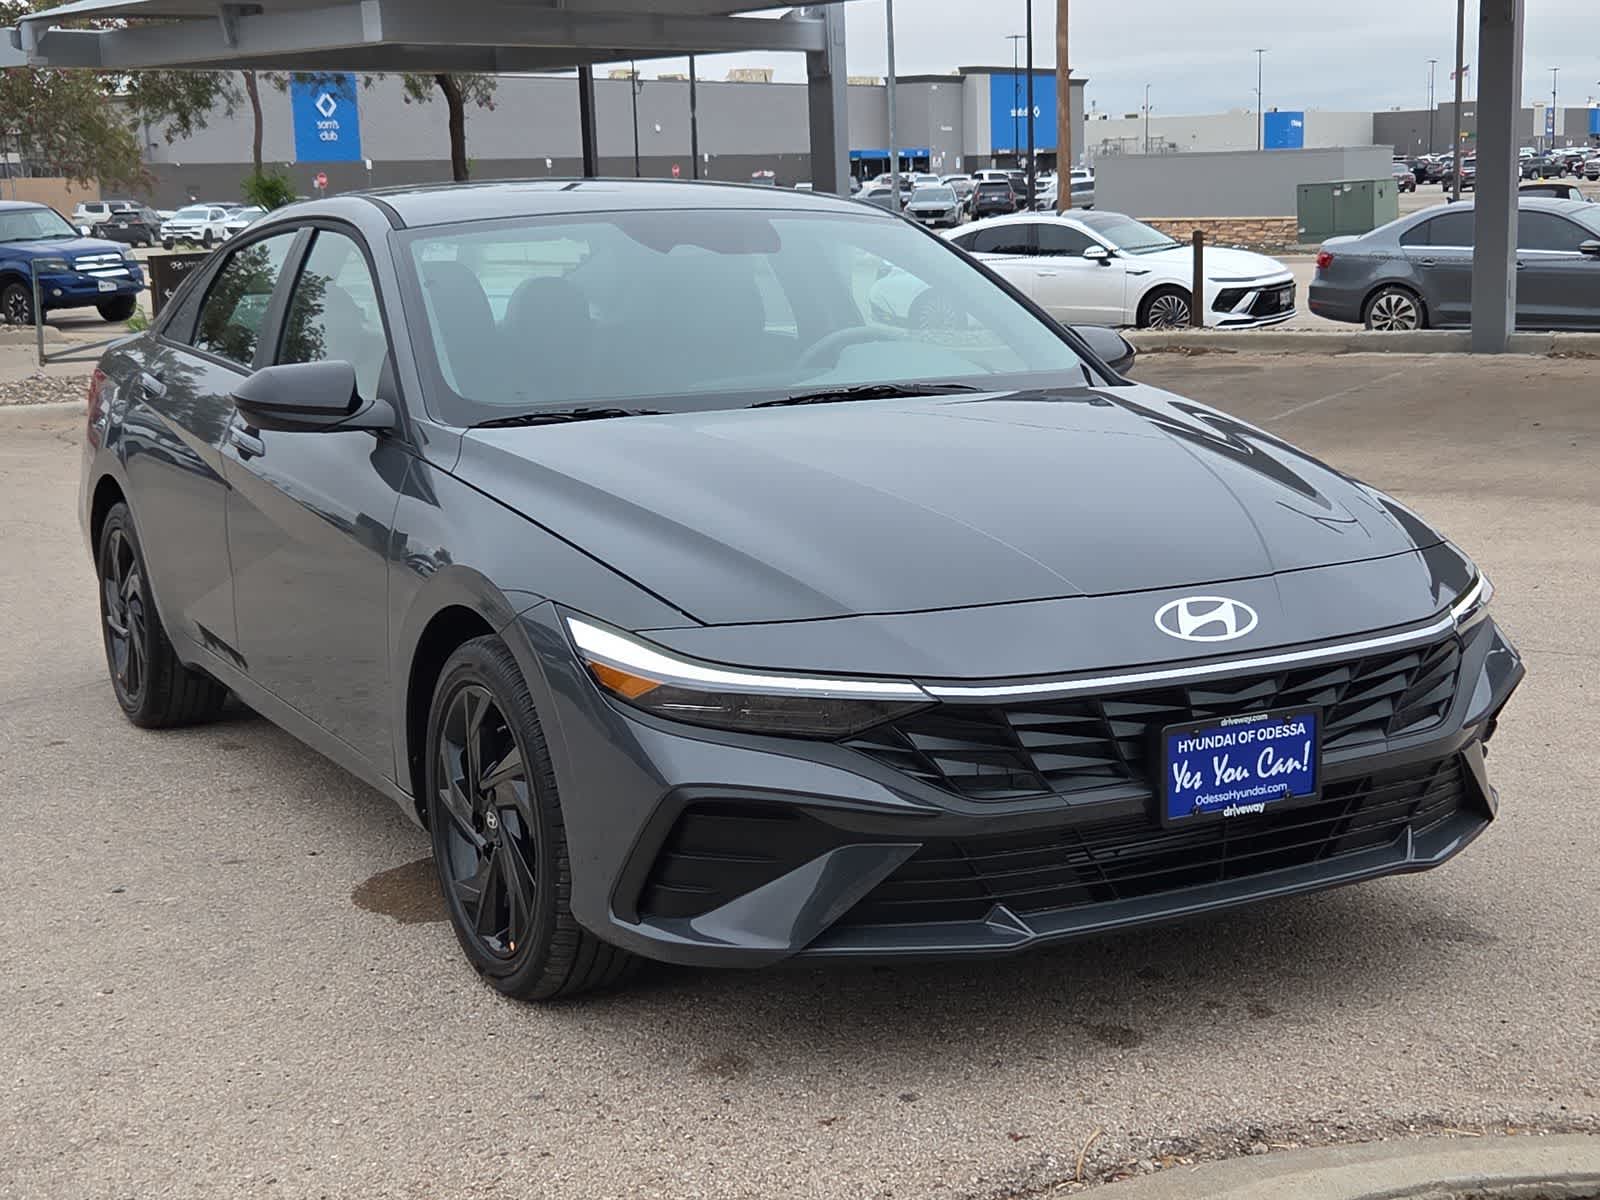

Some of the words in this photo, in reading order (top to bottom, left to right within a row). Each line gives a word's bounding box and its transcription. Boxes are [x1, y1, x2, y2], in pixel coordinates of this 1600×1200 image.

[1220, 713, 1268, 727] driveway.com
[1178, 733, 1236, 753] HYUNDAI
[1238, 729, 1256, 744] OF
[1257, 722, 1306, 741] ODESSA
[1172, 759, 1203, 793] Yes
[1212, 753, 1250, 787] You
[1256, 740, 1311, 779] Can!
[1195, 783, 1288, 806] OdessaHyundai.com
[1223, 802, 1266, 817] driveway
